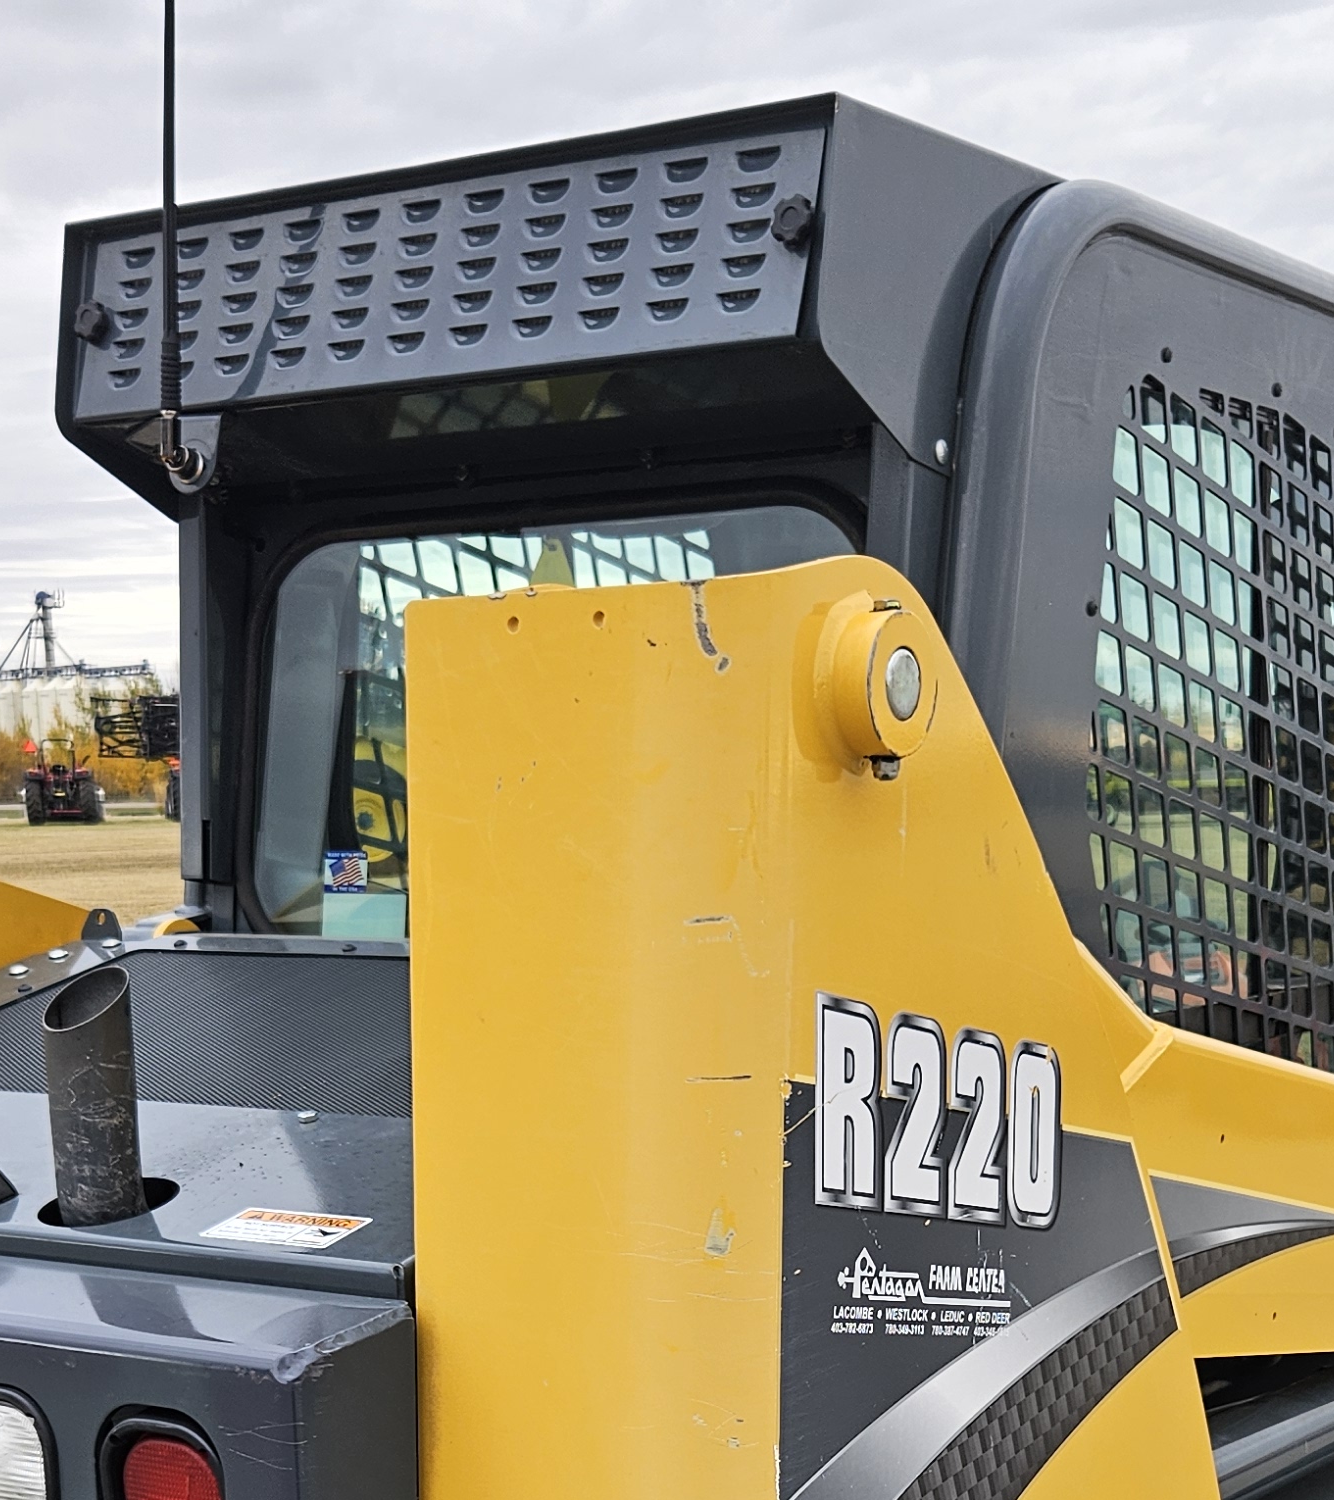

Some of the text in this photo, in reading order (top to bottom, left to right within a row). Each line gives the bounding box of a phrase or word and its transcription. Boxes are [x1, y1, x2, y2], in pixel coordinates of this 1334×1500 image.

[815, 990, 1063, 1230] R220
[269, 1213, 351, 1227] WARNING
[852, 1247, 923, 1302] Pentagon
[833, 1306, 1011, 1325] LACOMBE WESTLOCK LEDUC RED DEER
